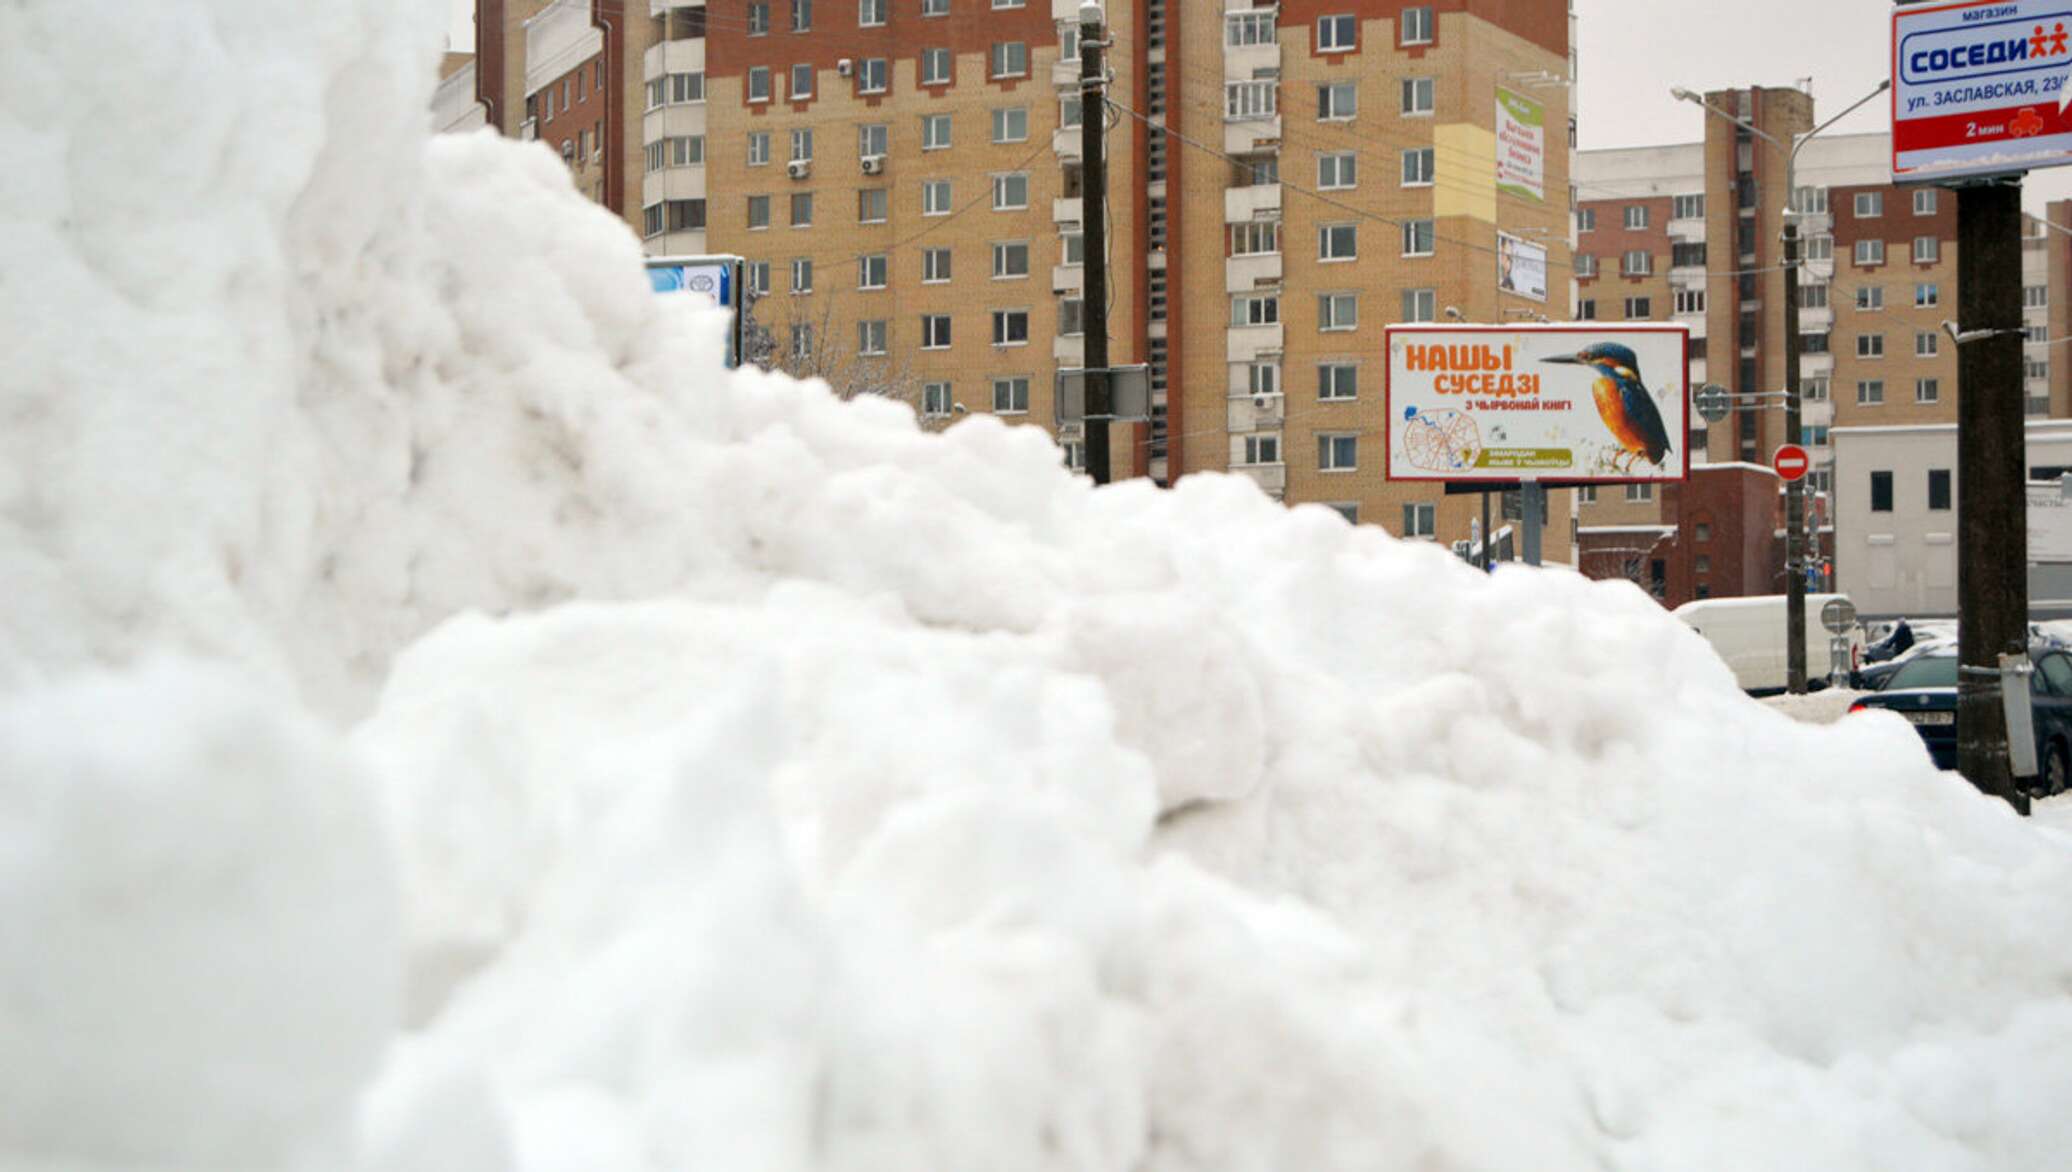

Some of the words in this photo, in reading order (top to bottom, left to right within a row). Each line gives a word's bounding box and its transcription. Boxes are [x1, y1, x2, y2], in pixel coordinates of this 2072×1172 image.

[1962, 5, 2018, 21] магазин
[1911, 38, 2028, 73] СОСЕДИ
[1907, 97, 1930, 112] ул.
[1934, 79, 2039, 106] ЗАСЛАВСКАЯ,
[1966, 122, 1977, 138] 2
[1979, 124, 2004, 135] мин
[1405, 344, 1514, 371] НАШЫ
[1433, 373, 1541, 398] СУСЕДЗІ
